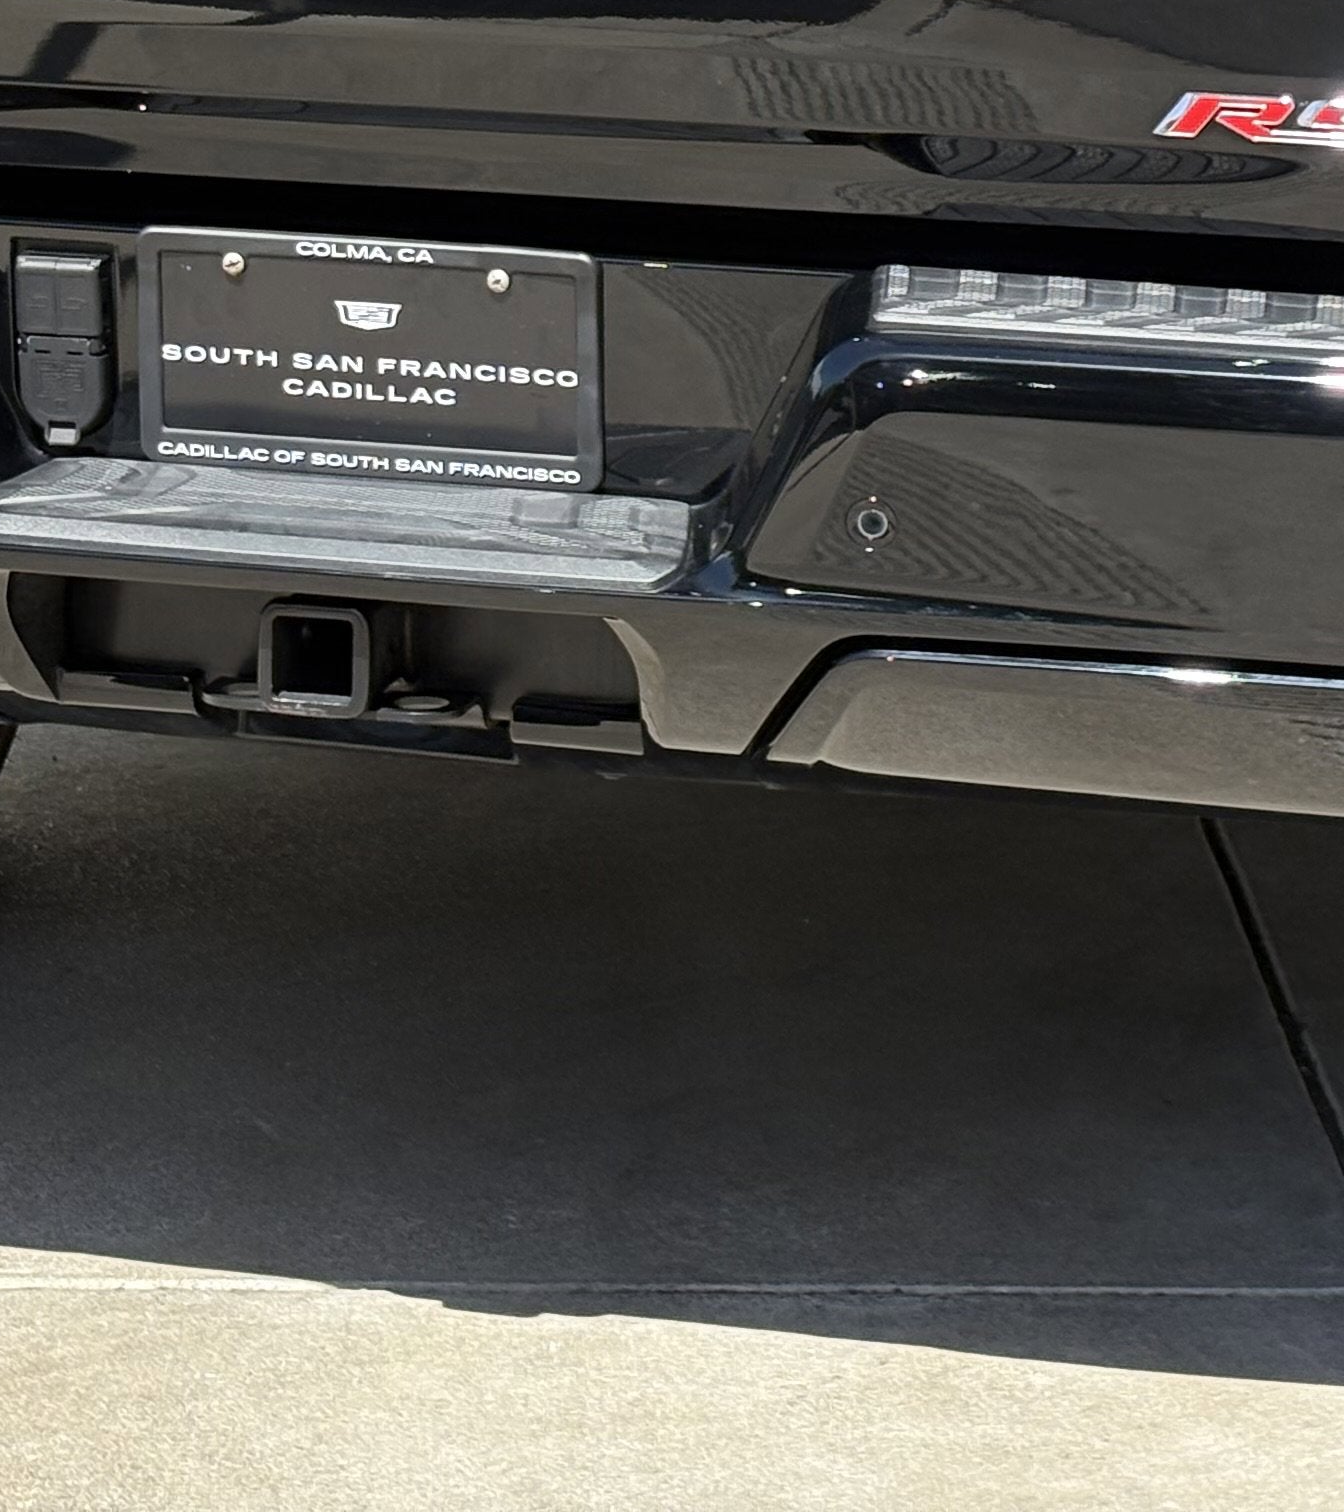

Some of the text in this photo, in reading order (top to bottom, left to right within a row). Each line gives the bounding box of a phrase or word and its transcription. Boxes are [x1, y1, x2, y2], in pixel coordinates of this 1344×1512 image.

[295, 241, 434, 265] COLMA, CA
[161, 344, 579, 388] SOUTH SAN FRANCISCO
[282, 379, 457, 406] CADILLAC
[157, 442, 581, 486] CADILLAC OF SOUTH SAN FRANCISCO
